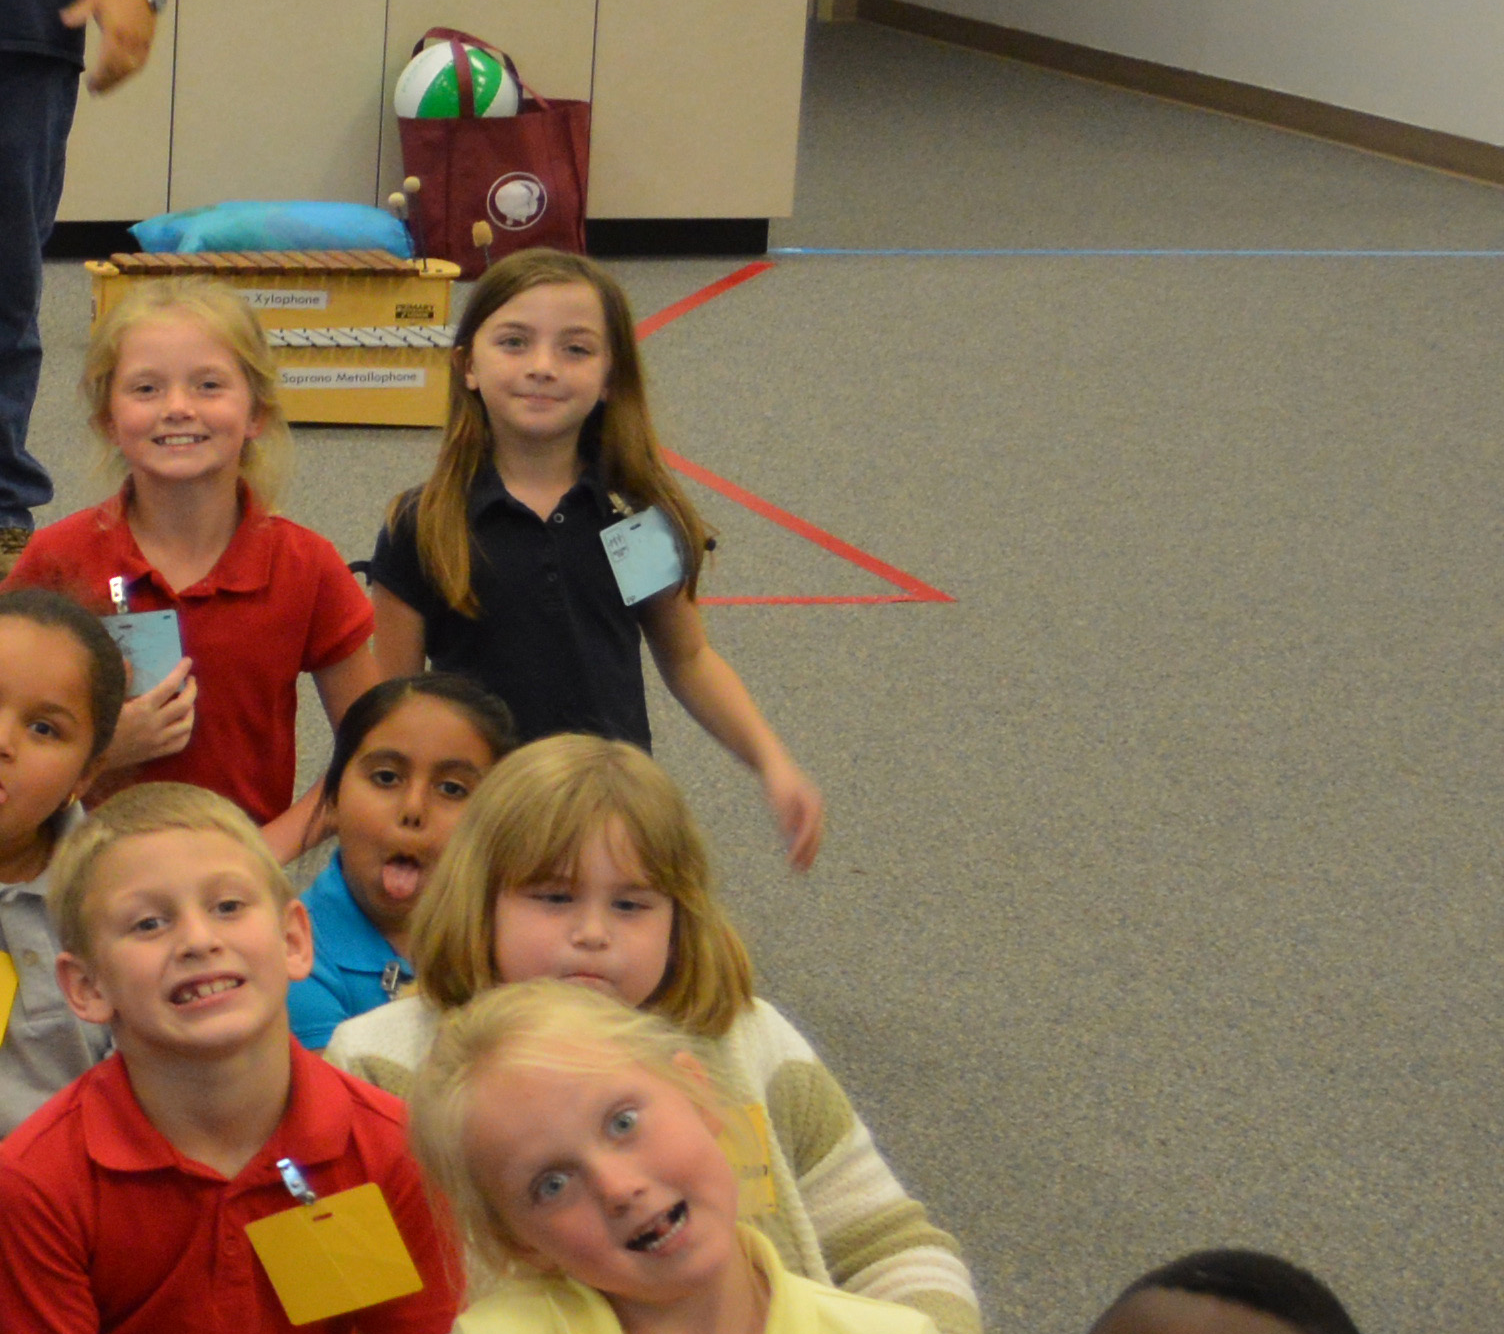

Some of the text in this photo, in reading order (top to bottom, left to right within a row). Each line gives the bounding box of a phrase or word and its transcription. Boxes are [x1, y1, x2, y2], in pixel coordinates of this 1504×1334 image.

[254, 295, 320, 308] Xylophone
[282, 370, 417, 385] Soprano Metallophone
